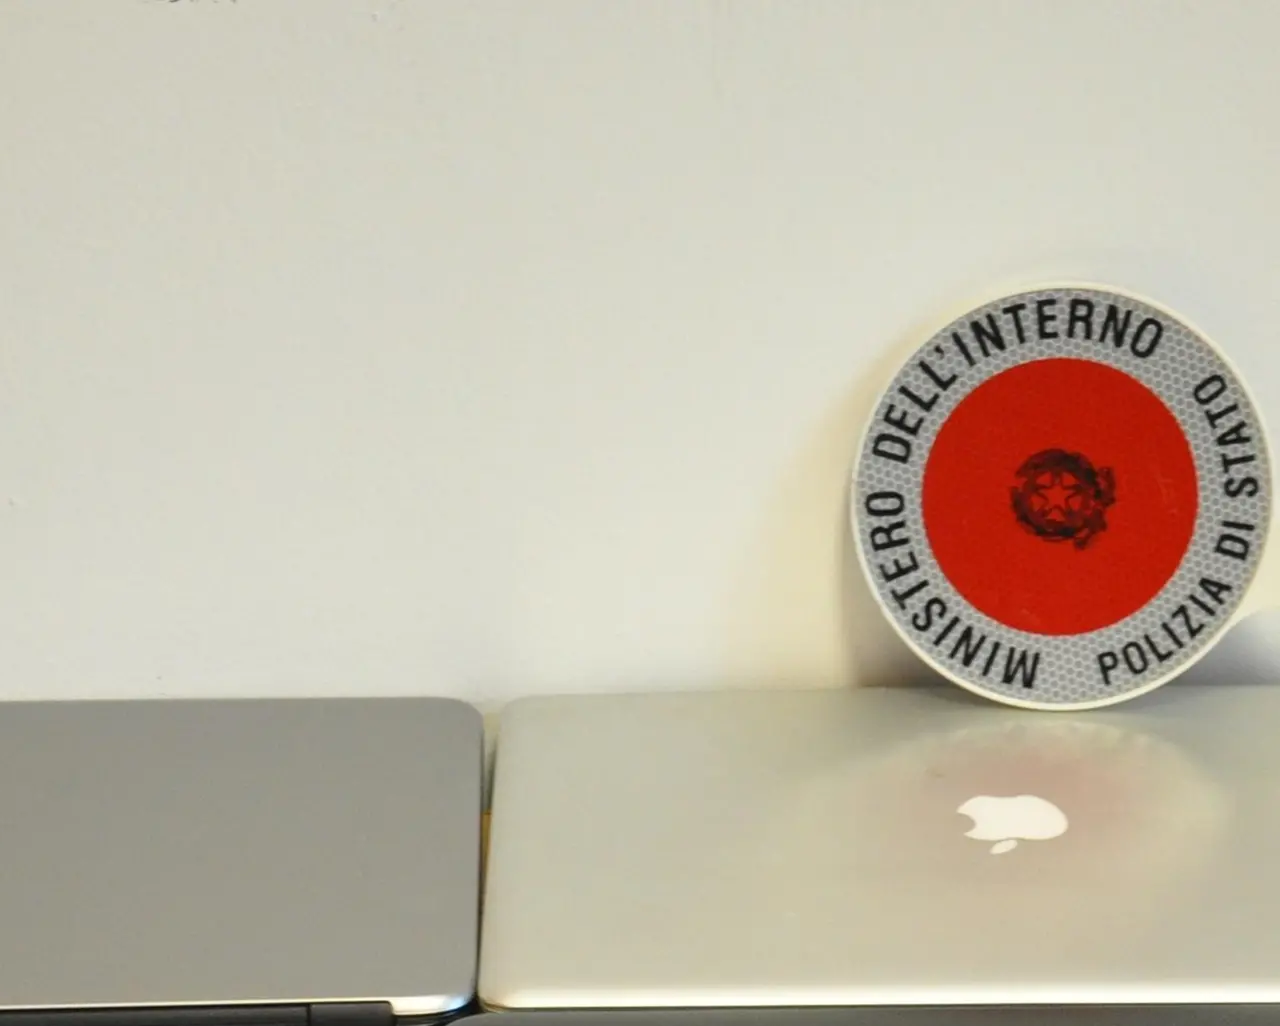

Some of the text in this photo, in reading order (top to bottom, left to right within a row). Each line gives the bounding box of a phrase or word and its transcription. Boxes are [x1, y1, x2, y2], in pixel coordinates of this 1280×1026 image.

[863, 298, 1164, 689] MINISTERO DELL'INTERNO
[1097, 373, 1259, 686] POLIZIA DI STATO
